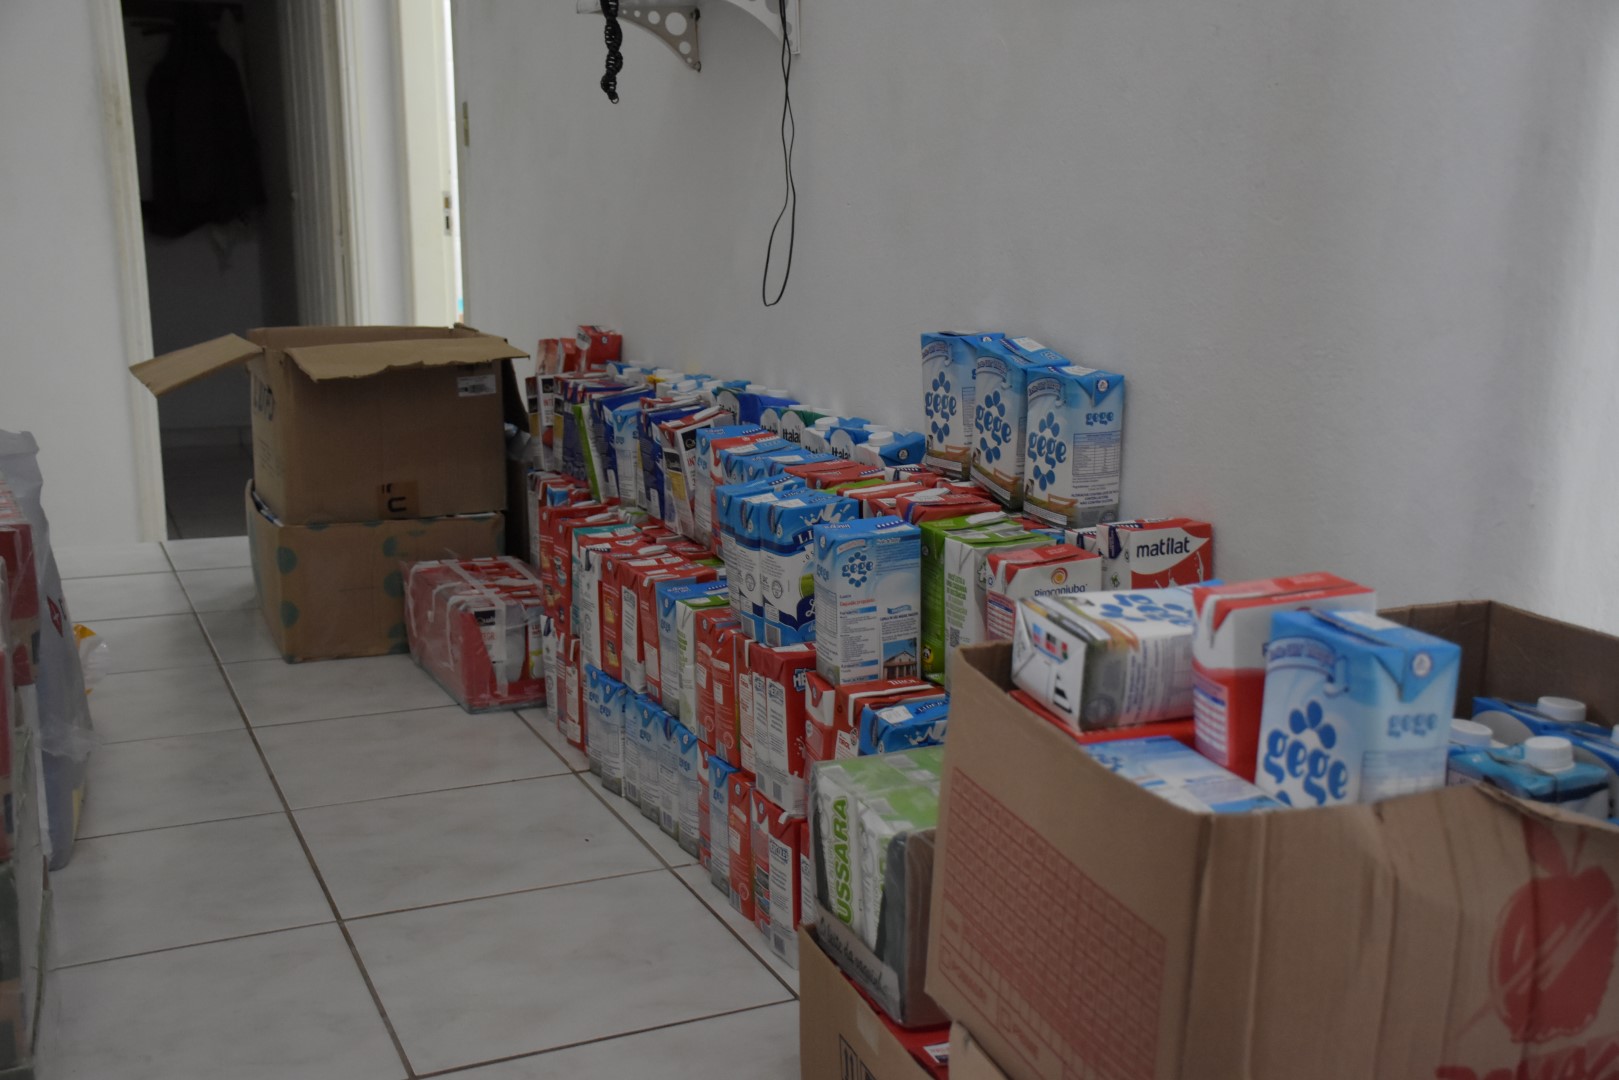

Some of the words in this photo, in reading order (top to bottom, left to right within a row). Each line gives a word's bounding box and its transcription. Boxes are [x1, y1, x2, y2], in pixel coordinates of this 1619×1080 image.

[925, 391, 957, 422] gege
[1085, 411, 1115, 427] gege
[975, 404, 1012, 446] gege
[1027, 431, 1067, 470] gege
[841, 560, 874, 578] gege
[1387, 712, 1439, 739] gege
[1262, 729, 1349, 806] gege
[833, 796, 853, 925] USSARA
